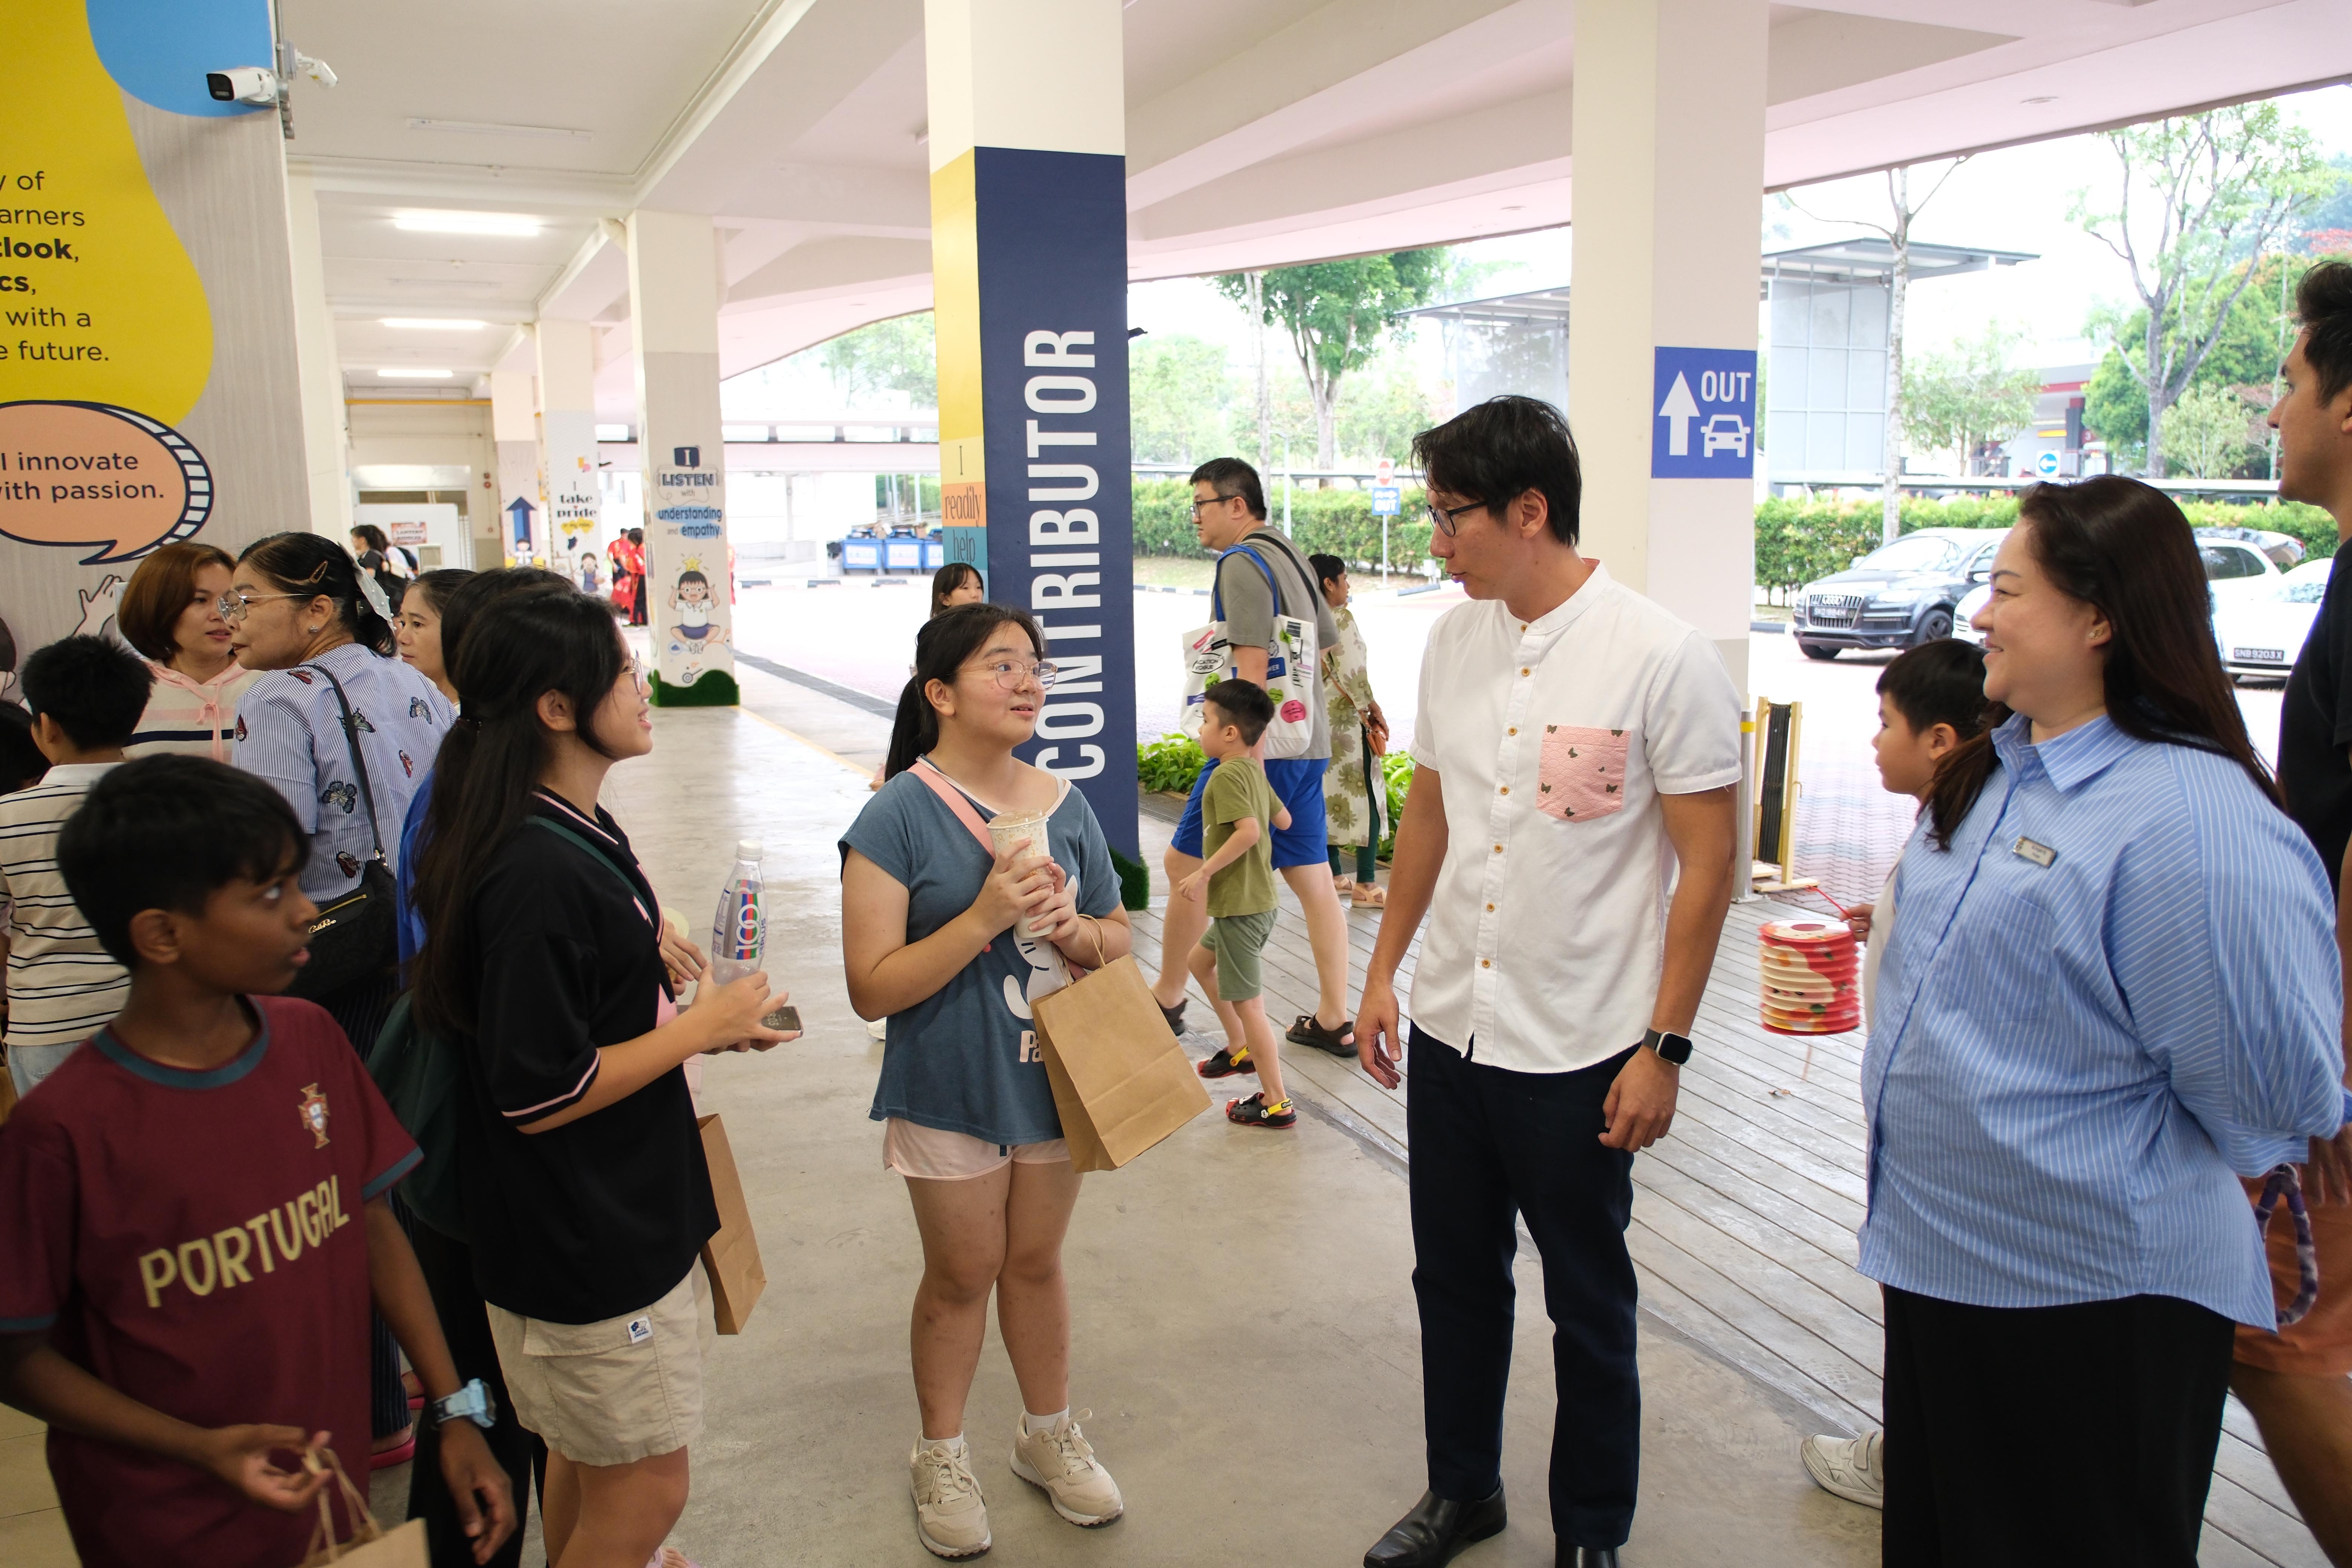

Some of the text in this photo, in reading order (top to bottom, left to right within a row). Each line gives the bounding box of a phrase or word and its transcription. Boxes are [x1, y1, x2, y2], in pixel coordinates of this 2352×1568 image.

[17, 171, 44, 190] of
[5, 307, 91, 327] with a
[18, 340, 109, 361] future.
[1701, 370, 1751, 402] OUT
[1, 452, 138, 470] I innovate
[684, 449, 691, 466] I
[959, 446, 963, 475] I
[662, 473, 714, 486] LISTEN
[52, 480, 164, 503] passion.
[559, 494, 593, 504] take
[557, 508, 597, 518] pride
[658, 507, 722, 522] understanding
[945, 485, 982, 528] readily
[1375, 499, 1396, 511] OUT
[681, 523, 723, 539] empathy.
[952, 529, 976, 565] help
[1024, 330, 1105, 780] CONTRIBUTOR
[735, 903, 761, 953] 100
[138, 1174, 350, 1308] PORTUGAL
